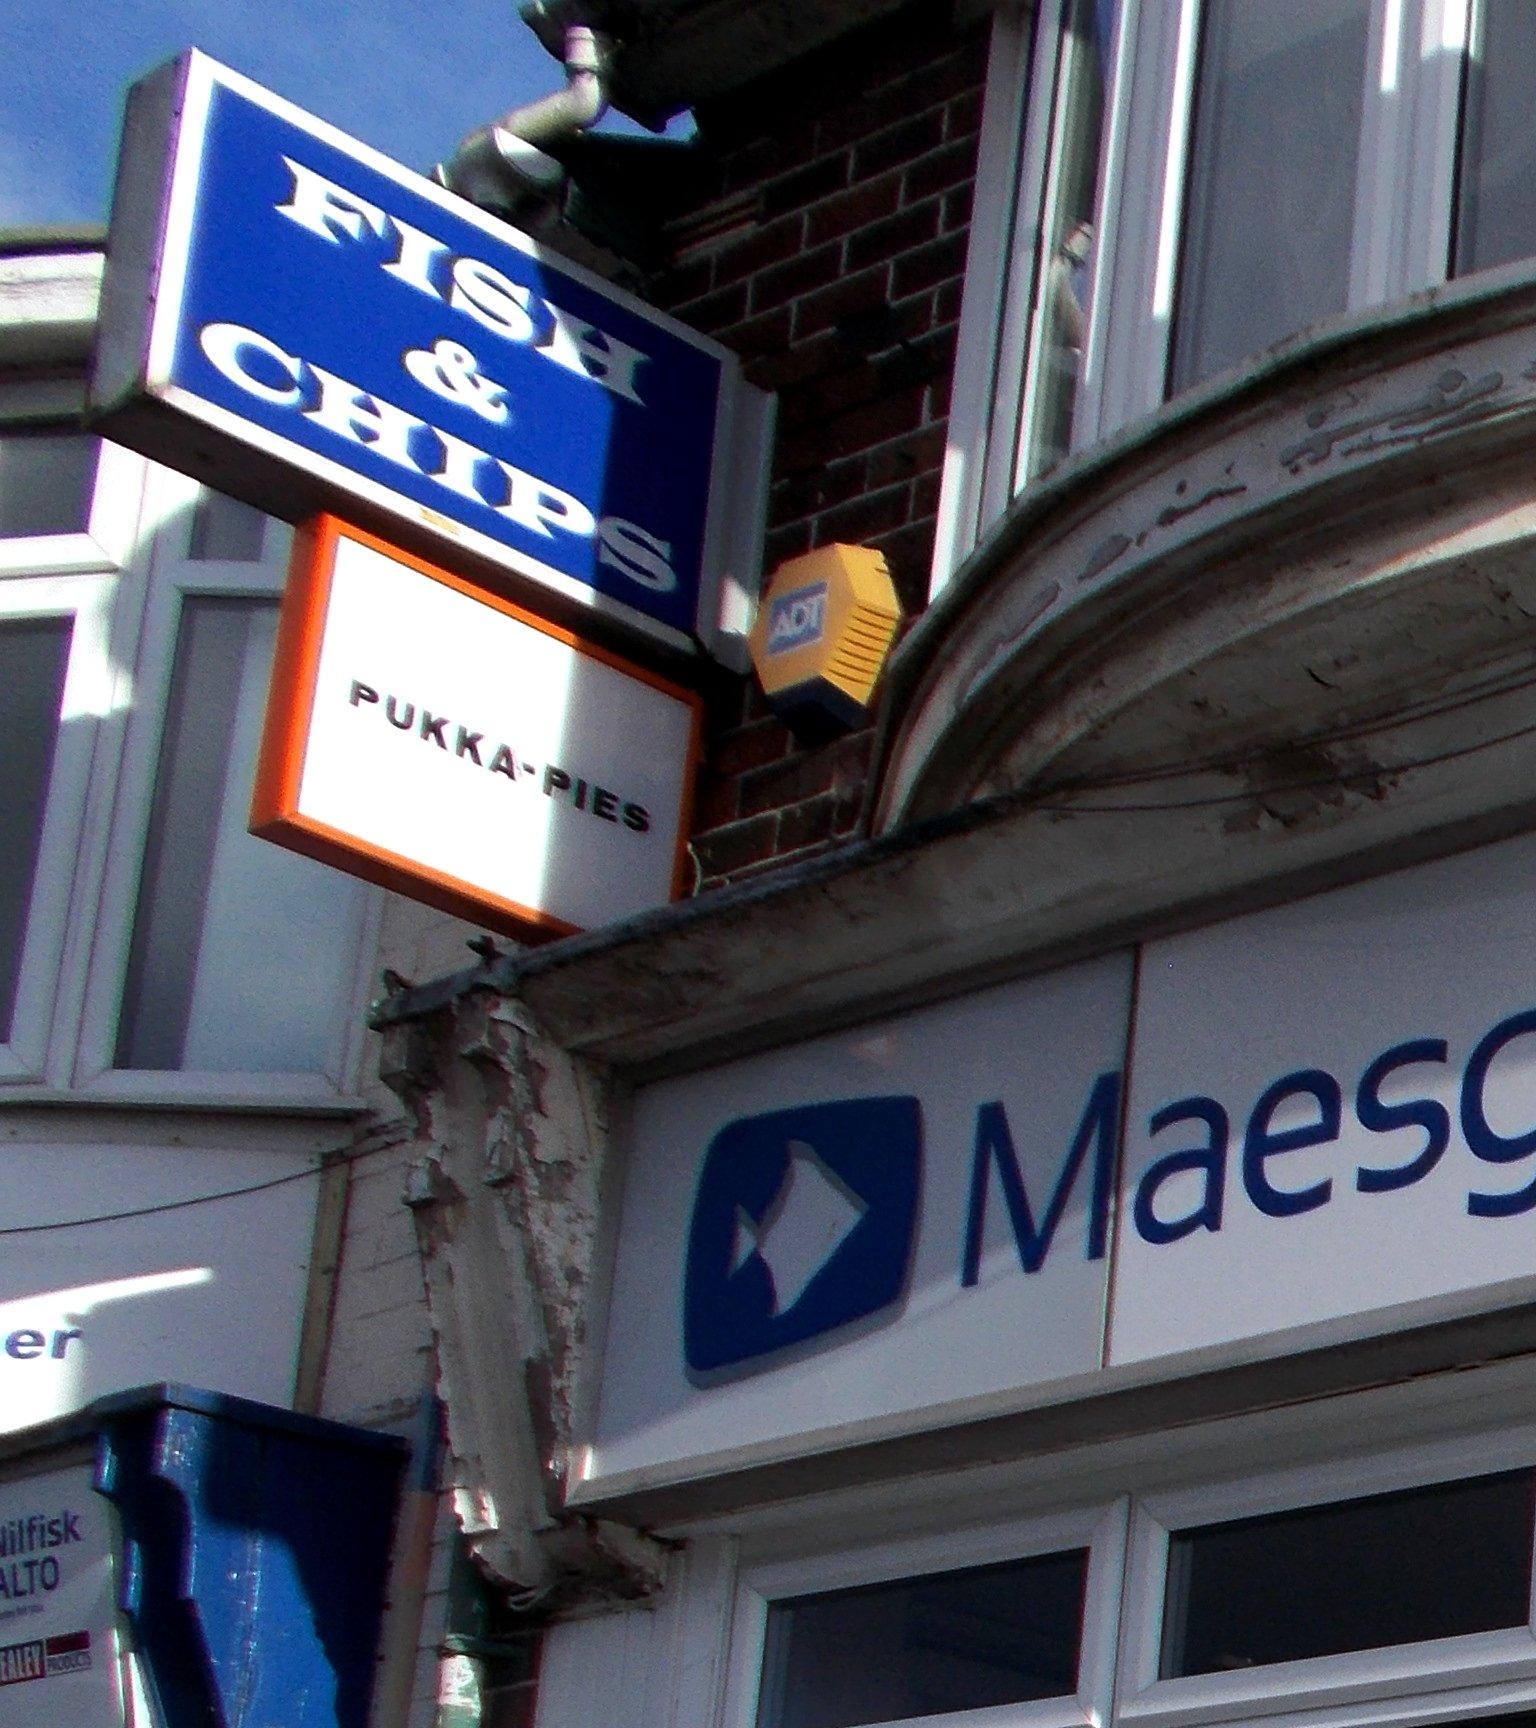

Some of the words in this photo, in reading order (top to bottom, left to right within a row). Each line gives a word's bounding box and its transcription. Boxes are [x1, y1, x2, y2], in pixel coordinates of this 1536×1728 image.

[275, 155, 652, 407] FISH
[404, 338, 512, 424] &
[199, 322, 679, 593] CHIPS
[772, 590, 826, 639] ADT
[349, 680, 650, 833] PUKKA-PIES
[4, 1328, 83, 1360] er
